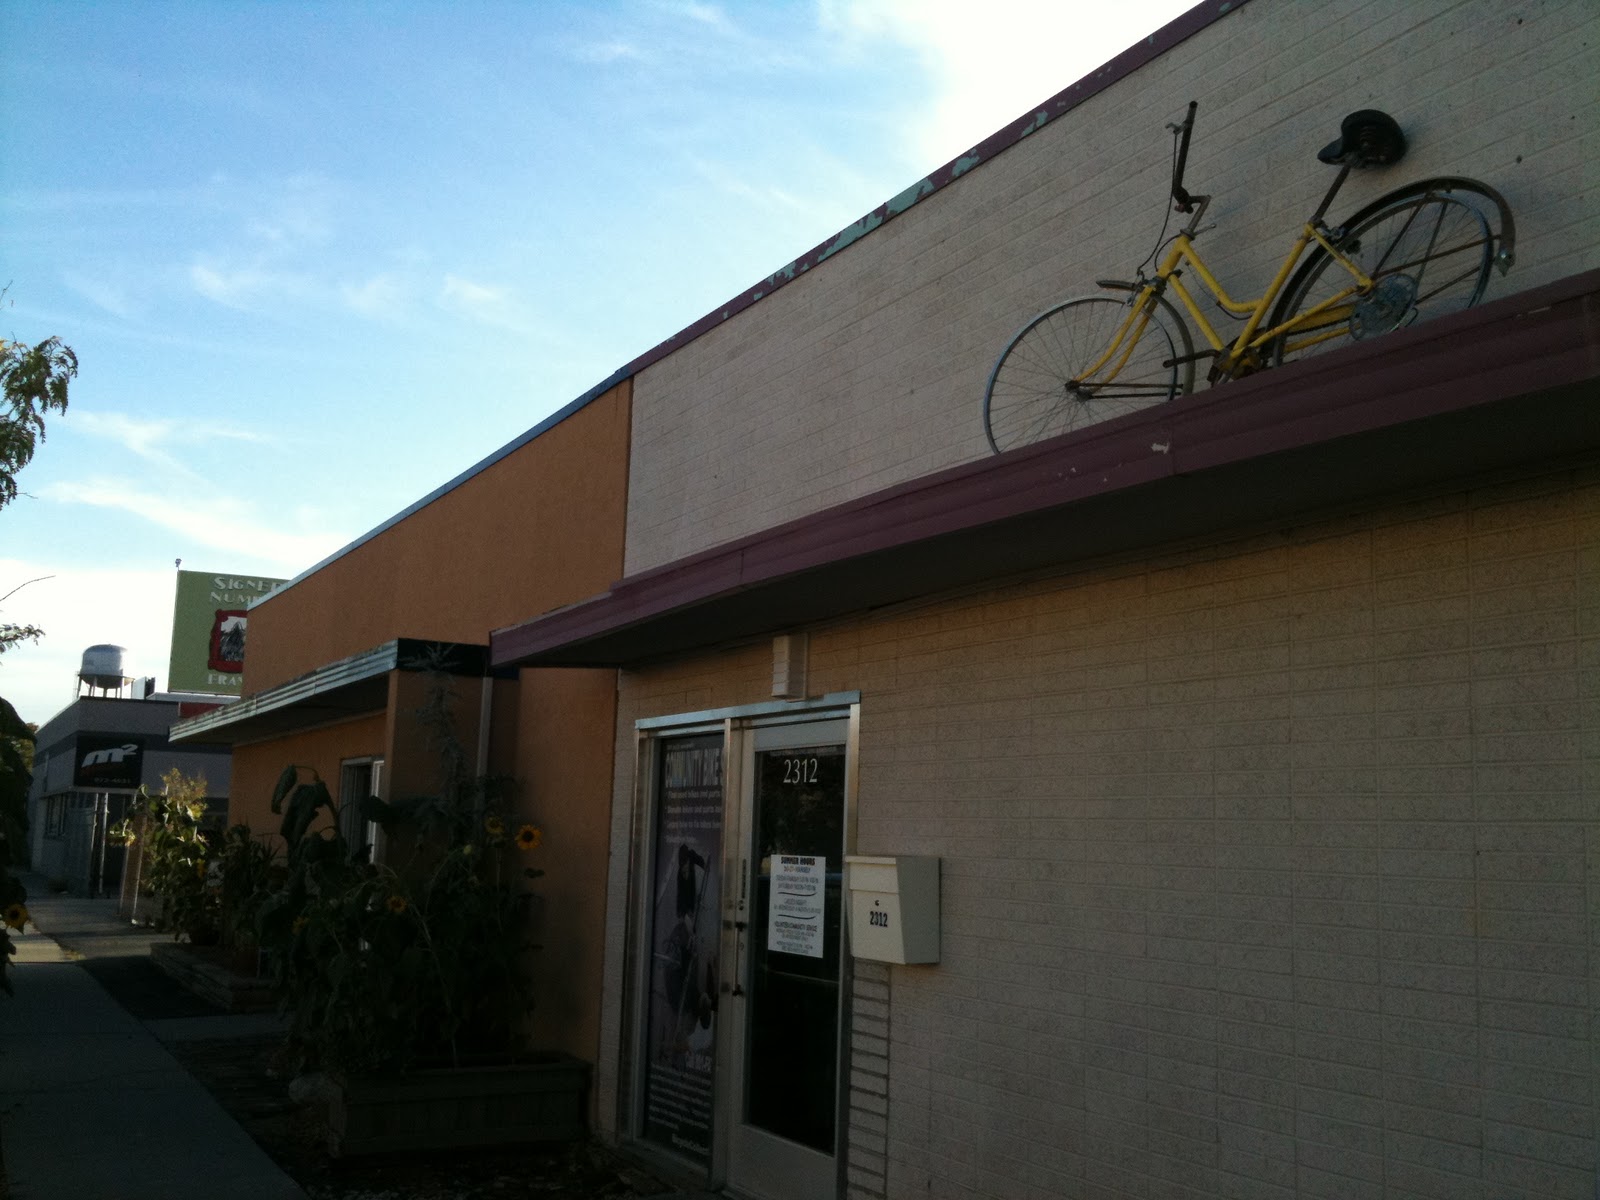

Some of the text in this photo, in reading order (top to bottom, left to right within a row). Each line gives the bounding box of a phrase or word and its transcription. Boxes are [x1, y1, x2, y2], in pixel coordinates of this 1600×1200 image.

[207, 673, 243, 686] FRA
[782, 757, 818, 785] 2312
[869, 910, 888, 928] 2312
